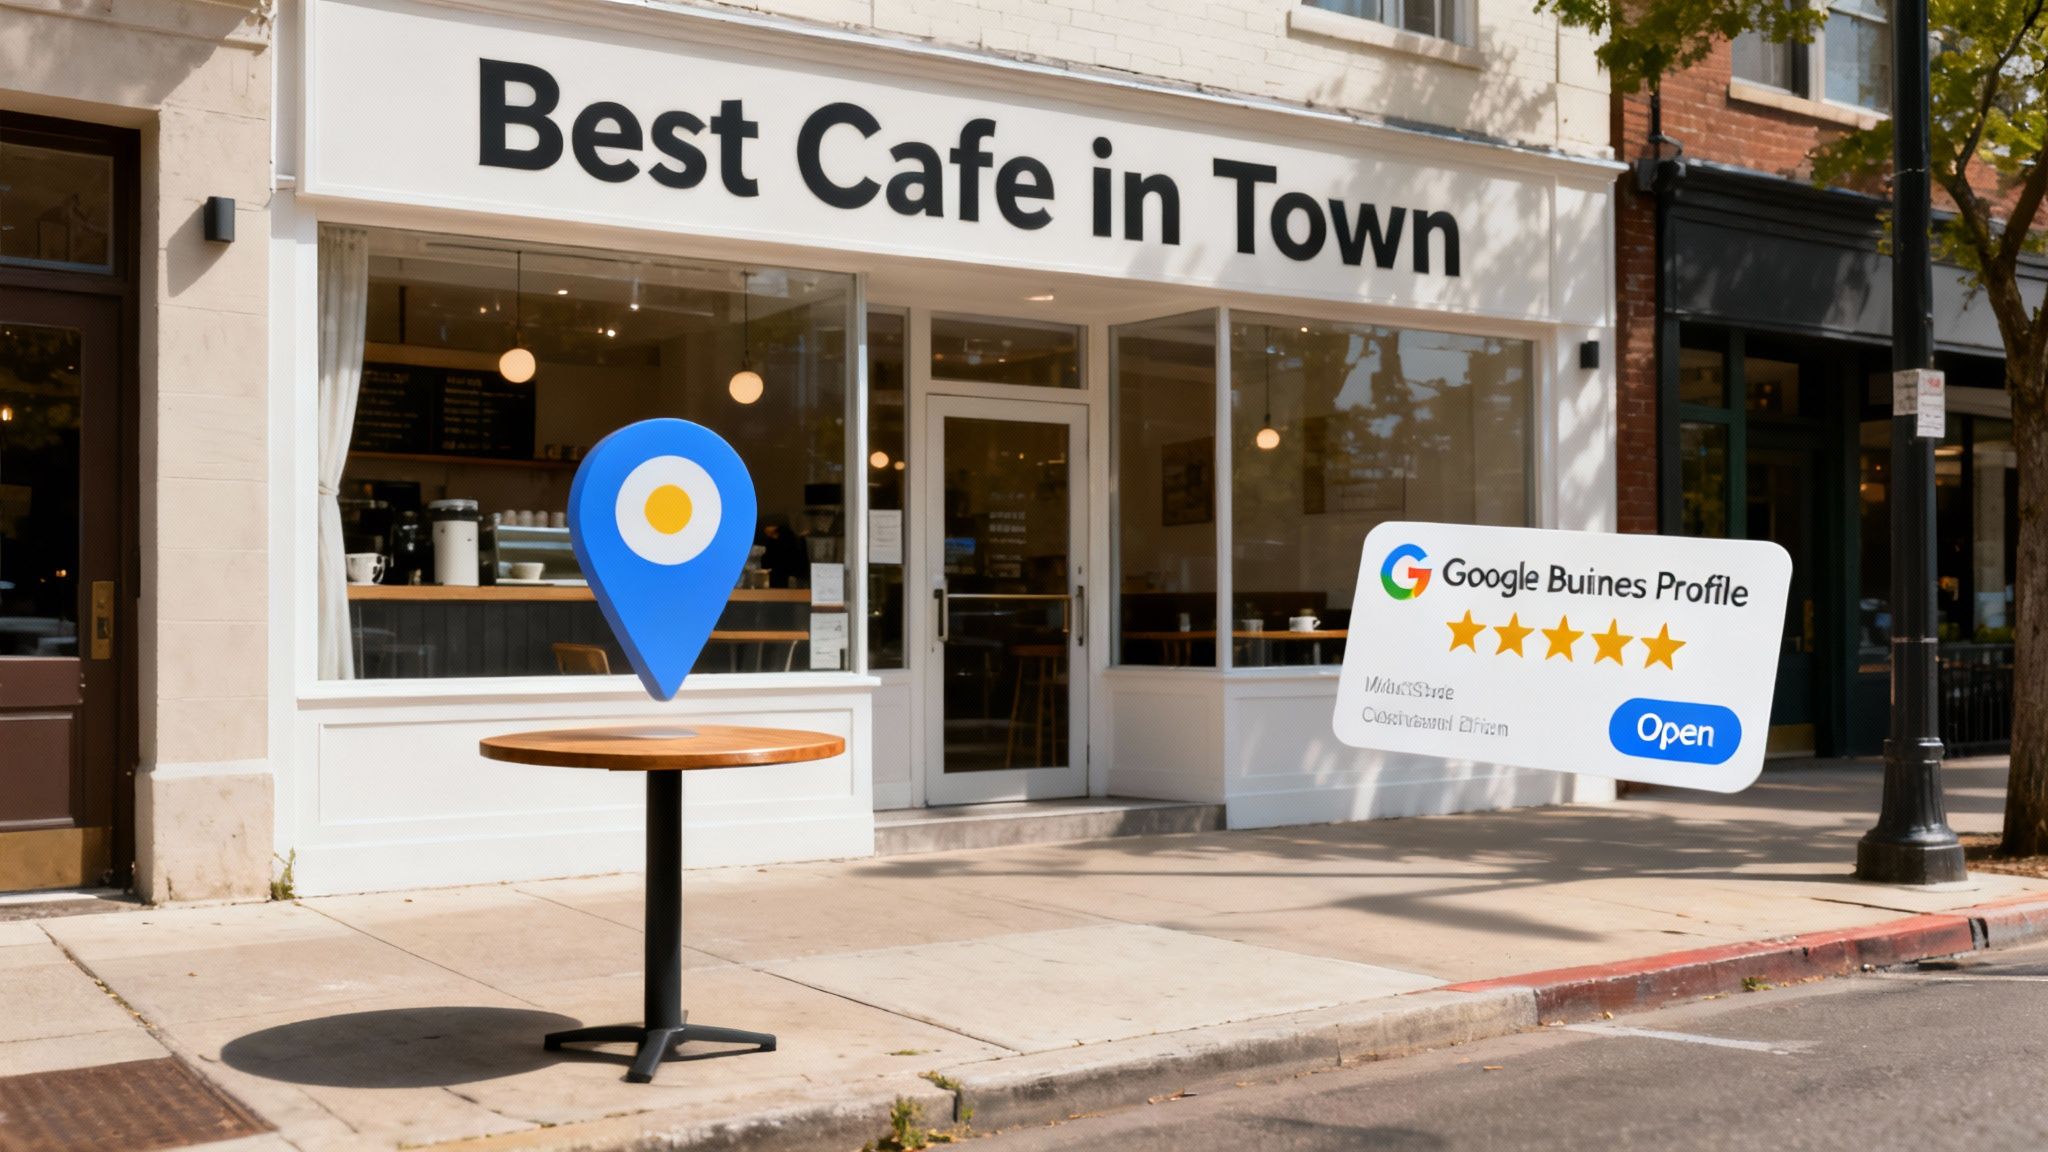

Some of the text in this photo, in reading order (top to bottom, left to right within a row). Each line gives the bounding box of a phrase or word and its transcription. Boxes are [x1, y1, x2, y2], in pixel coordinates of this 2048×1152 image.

[479, 57, 1461, 277] Best Cafe in Town
[1442, 557, 1540, 598] Google
[1655, 571, 1749, 608] Profile
[1636, 712, 1715, 751] Open
